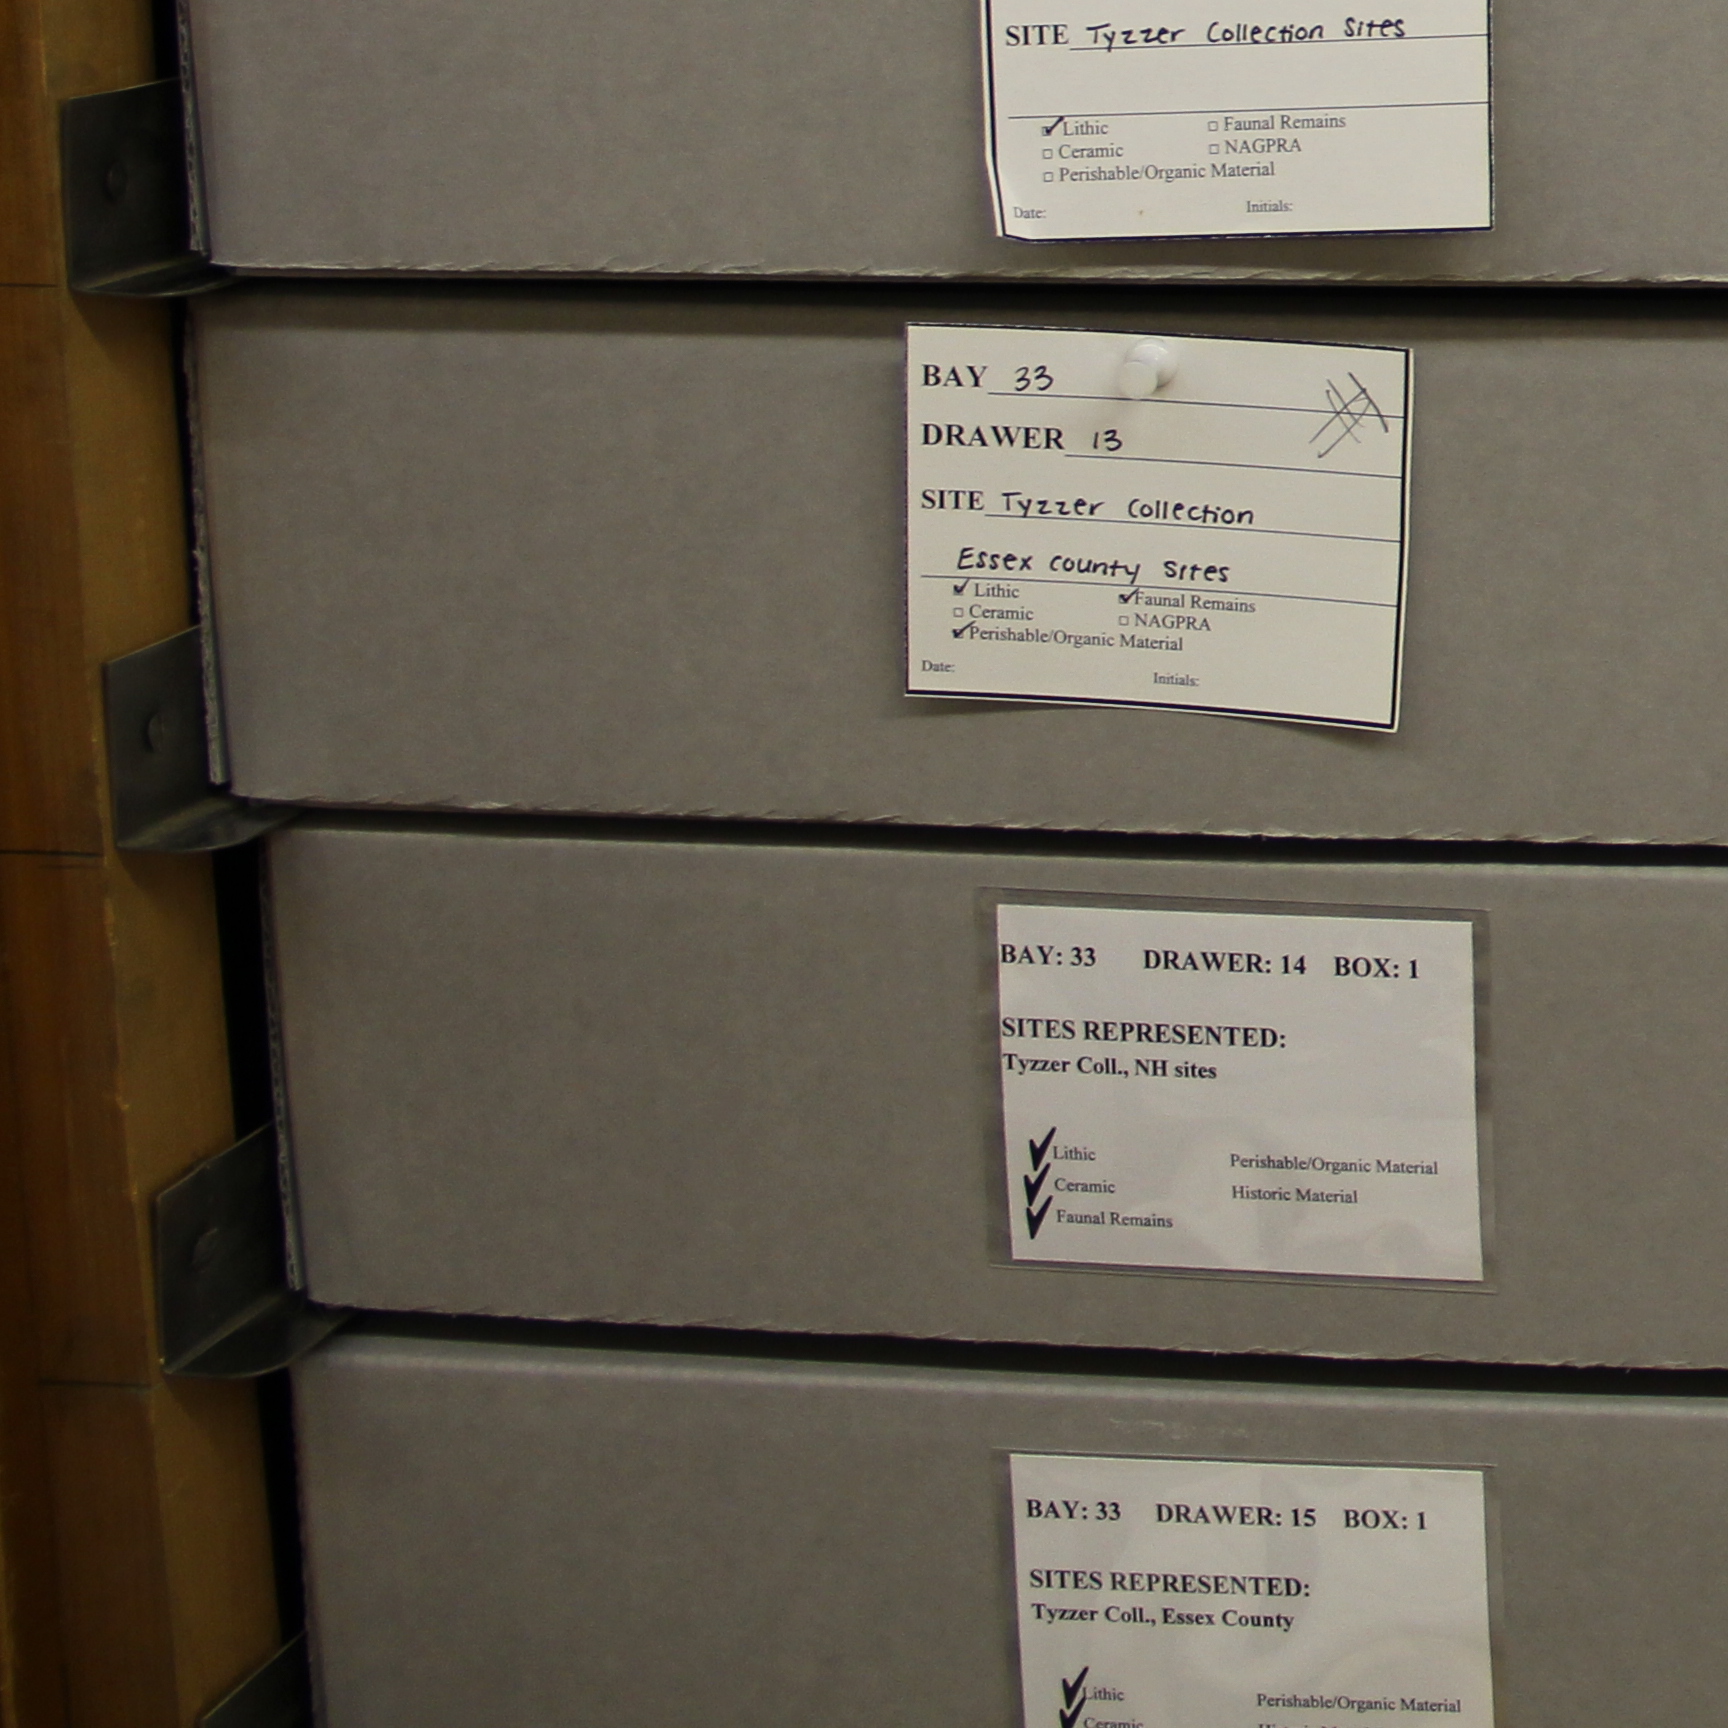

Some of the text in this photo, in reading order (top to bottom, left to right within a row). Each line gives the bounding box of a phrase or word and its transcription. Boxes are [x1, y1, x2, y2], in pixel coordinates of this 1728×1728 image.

[1005, 24, 1069, 47] SITE
[1085, 21, 1187, 52] Tyzzer
[1206, 21, 1325, 44] Collection
[1223, 114, 1346, 133] Faunal Remains
[921, 364, 1055, 392] BAY 33
[921, 423, 1123, 452] DRAWER 13
[921, 489, 985, 511] SITE
[1002, 491, 1106, 518] Tyzzer
[956, 546, 1033, 573] Essex
[1000, 944, 1419, 979] BAY: 33 DRAWER: 14 BOX: 1
[1002, 1018, 1287, 1049] SITES REPRESENTED:
[1002, 1053, 1217, 1079] Tyzzer Coll., NH sites
[1026, 1498, 1428, 1531] BAY: 33 DRAWER: 15 BOX: 1
[1029, 1568, 1311, 1599] SITES REPRESENTED:
[1031, 1603, 1295, 1632] Tyzzer Coll., Essex County
[1257, 1693, 1462, 1714] Perishable/Organic Material
